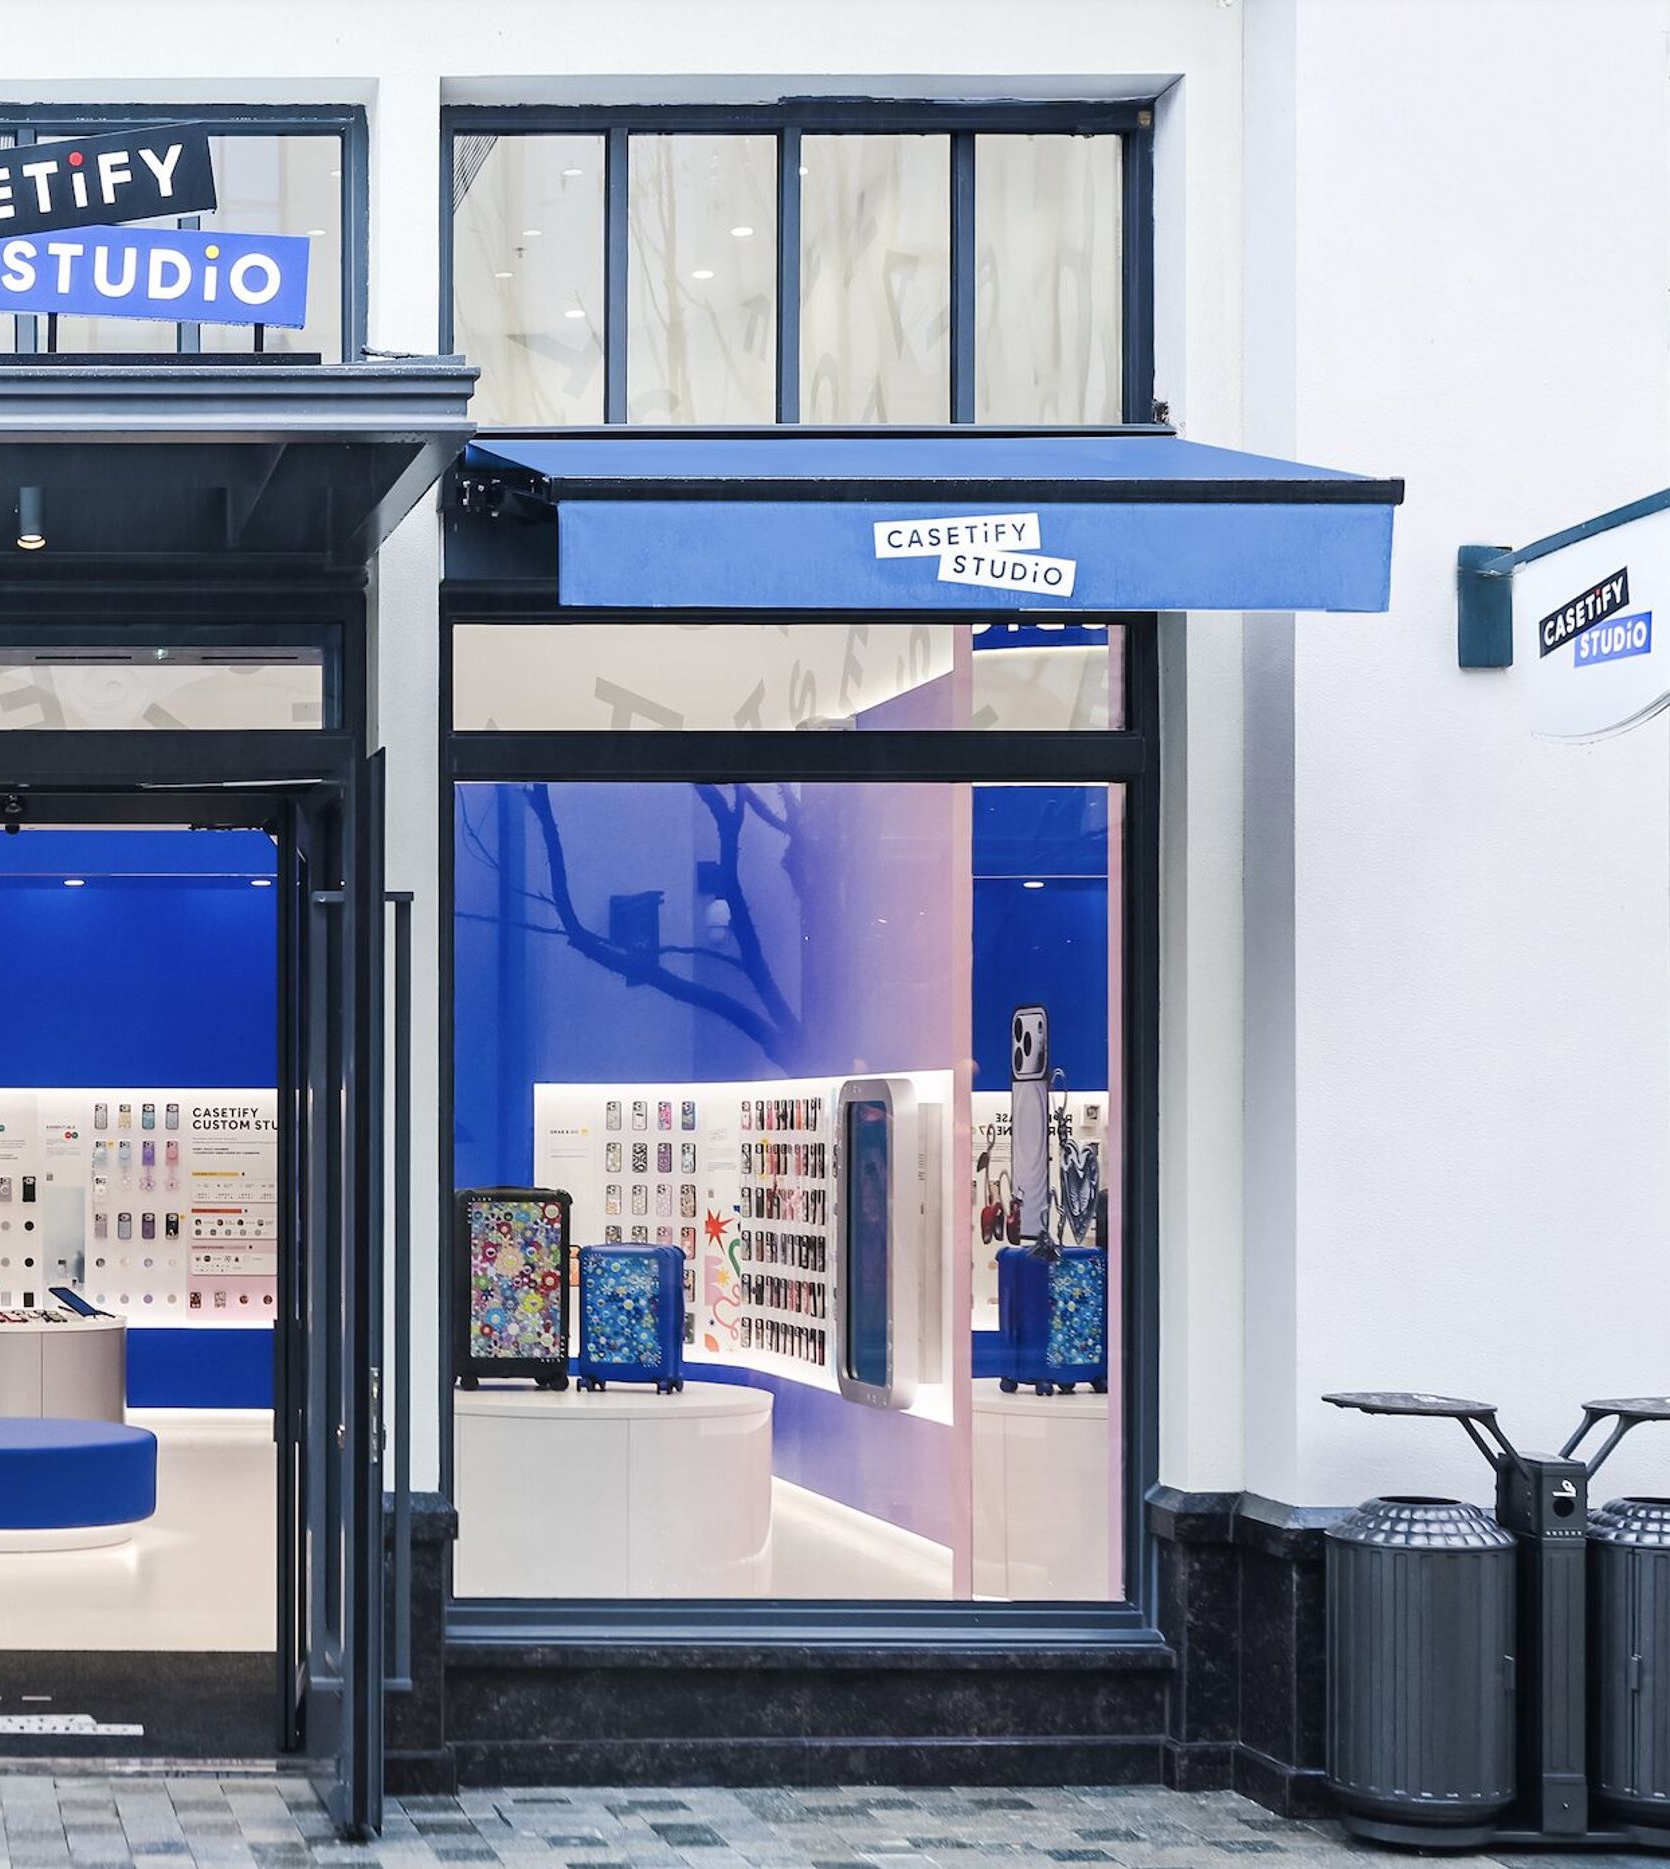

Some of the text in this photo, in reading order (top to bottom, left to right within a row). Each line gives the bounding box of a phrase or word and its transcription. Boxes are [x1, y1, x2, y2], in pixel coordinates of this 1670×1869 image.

[1, 240, 281, 305] STUDiO
[887, 522, 1025, 549] CASETiFY
[952, 554, 1062, 586] STUDiO
[1543, 576, 1623, 647] CASETiFY
[1580, 620, 1647, 659] STUDiO
[192, 1107, 259, 1118] CASETiFY
[192, 1119, 251, 1131] CUSTOM
